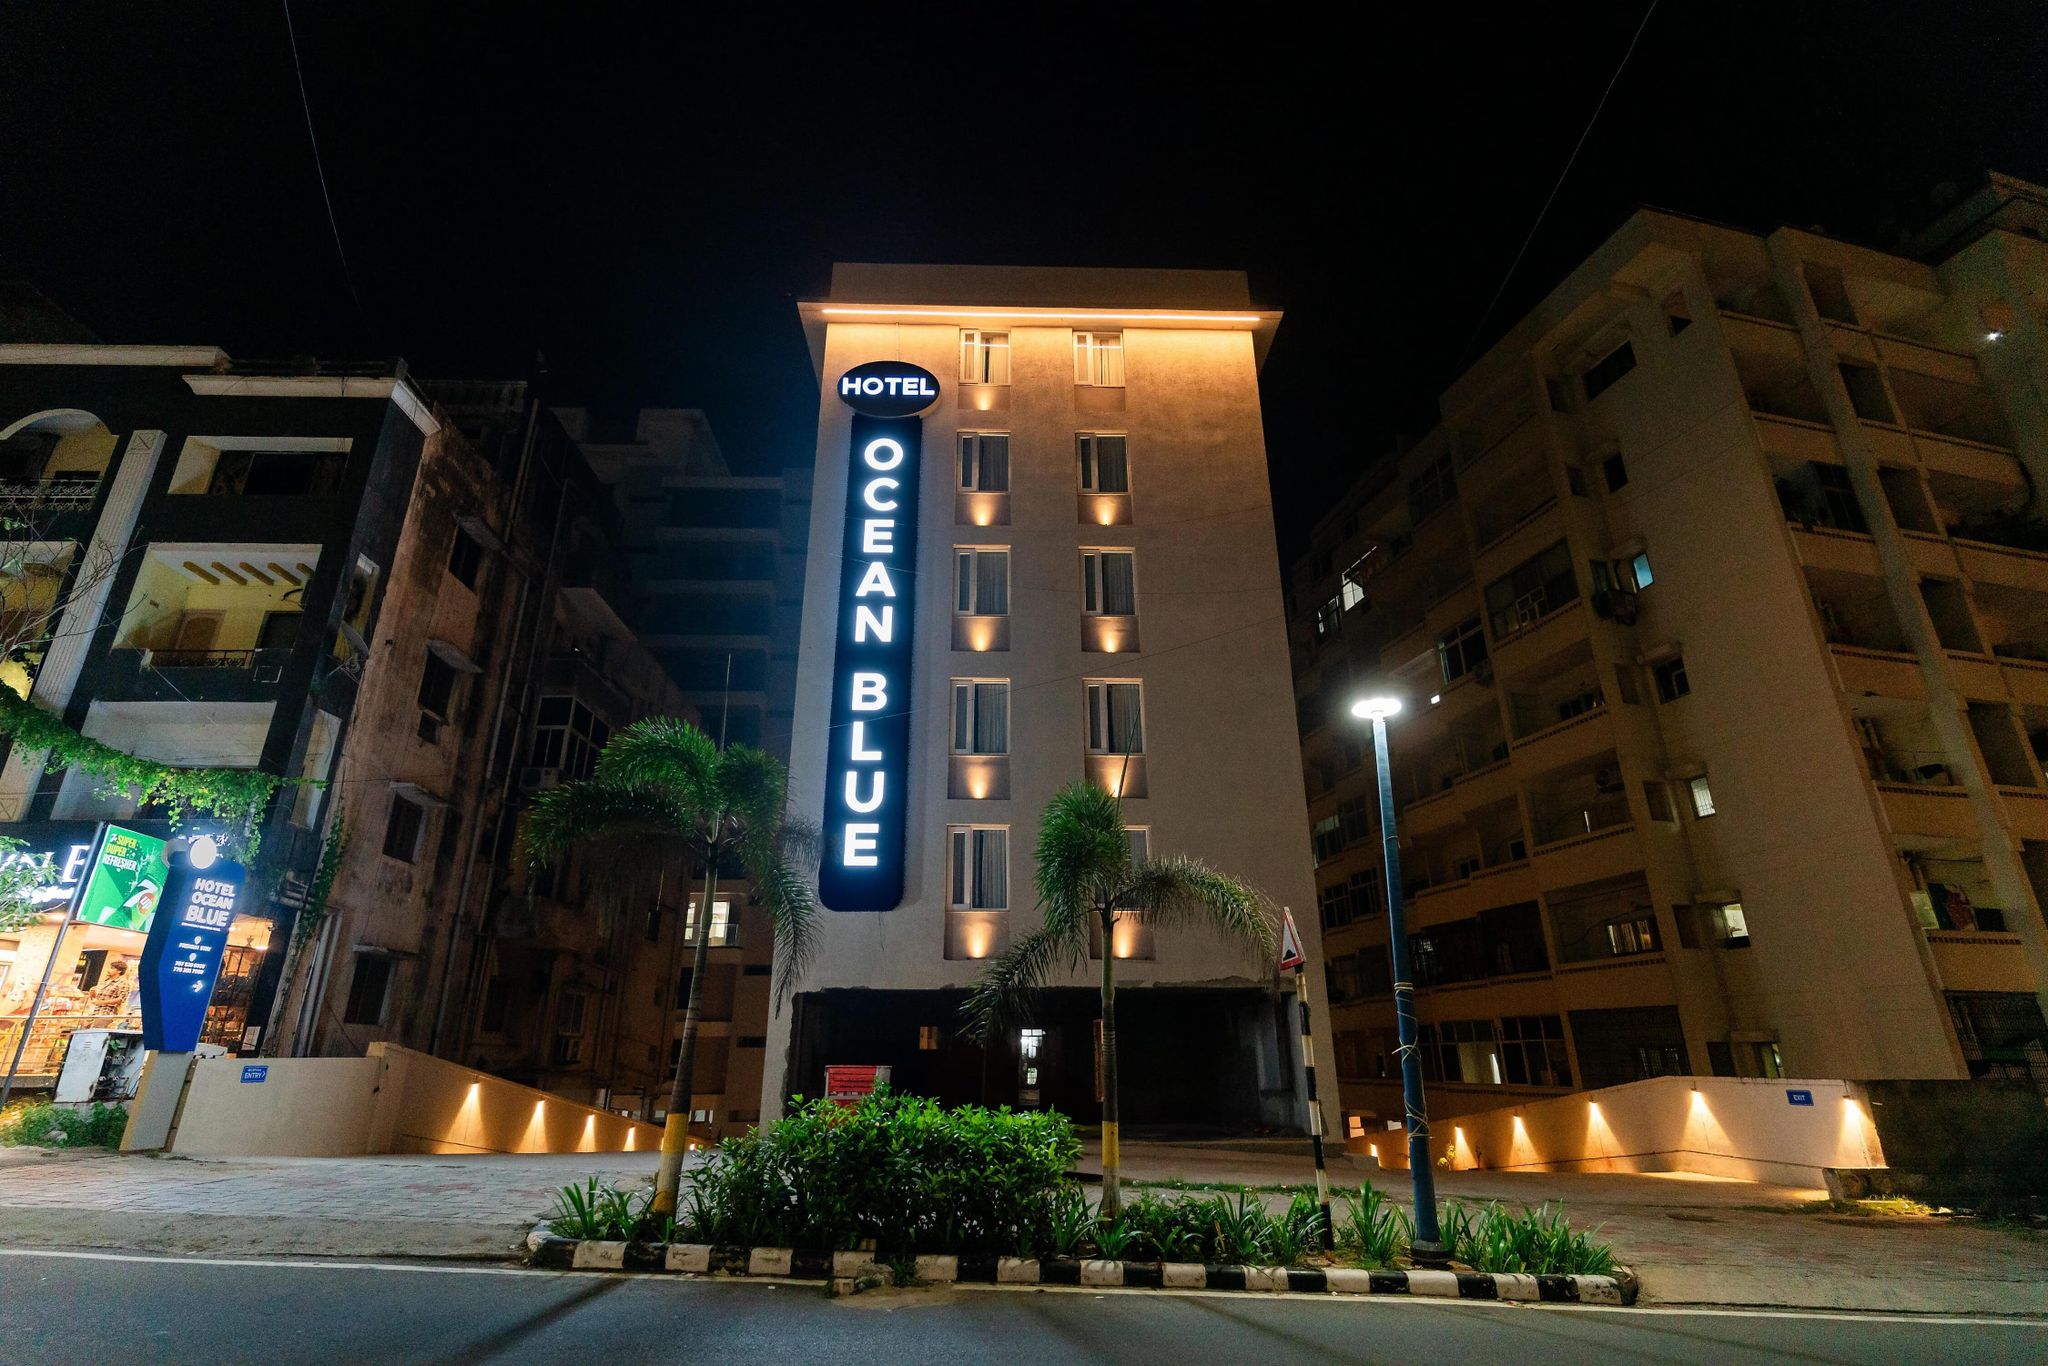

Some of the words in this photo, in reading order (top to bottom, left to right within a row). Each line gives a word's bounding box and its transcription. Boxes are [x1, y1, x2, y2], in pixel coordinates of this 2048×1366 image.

[842, 377, 936, 396] HOTEL
[854, 438, 904, 643] OCEAN
[843, 672, 888, 867] BLUE
[102, 853, 137, 871] REFRESHER
[194, 878, 236, 898] HOTEL
[191, 891, 234, 910] OCEAN
[185, 904, 230, 927] BLUE
